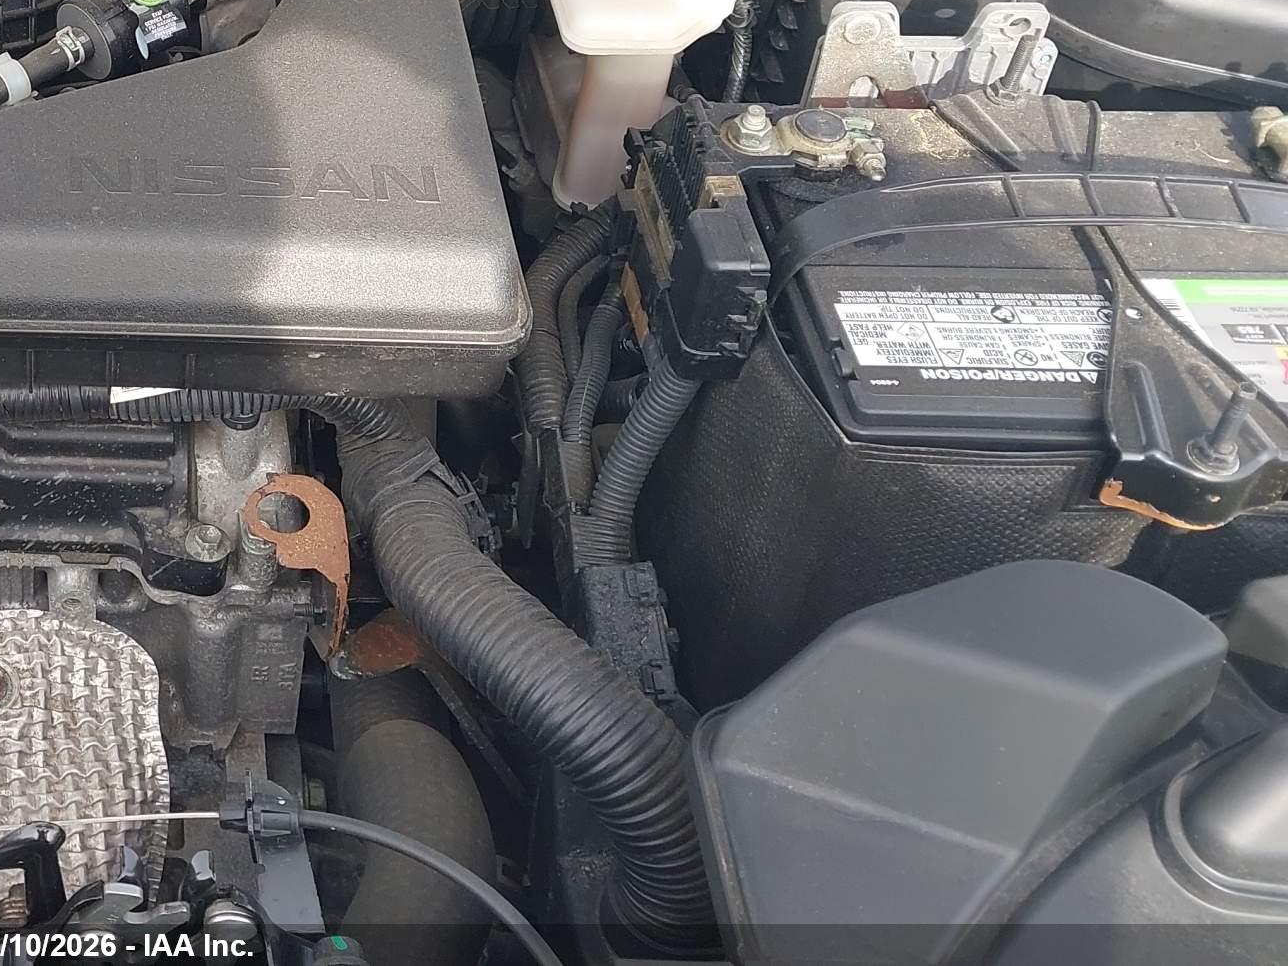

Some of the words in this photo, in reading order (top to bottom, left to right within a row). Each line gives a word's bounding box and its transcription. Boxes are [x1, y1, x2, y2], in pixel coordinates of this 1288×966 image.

[69, 154, 442, 204] NISSAN
[877, 312, 899, 320] OPEN
[899, 312, 916, 320] NOT
[845, 323, 869, 331] FAST.
[872, 323, 893, 332] HELP
[848, 330, 887, 339] MEDICAL
[852, 338, 869, 346] GET
[872, 341, 906, 349] WATER.
[907, 341, 930, 349] WITH
[1061, 341, 1090, 350] GASES
[876, 348, 934, 357] IMMEDIATELY
[983, 349, 1004, 357] ACID
[886, 356, 909, 364] EYES
[910, 357, 938, 365] FLUSH
[966, 357, 1009, 365] SULFURIC
[919, 368, 1082, 383] DANGER/POISON
